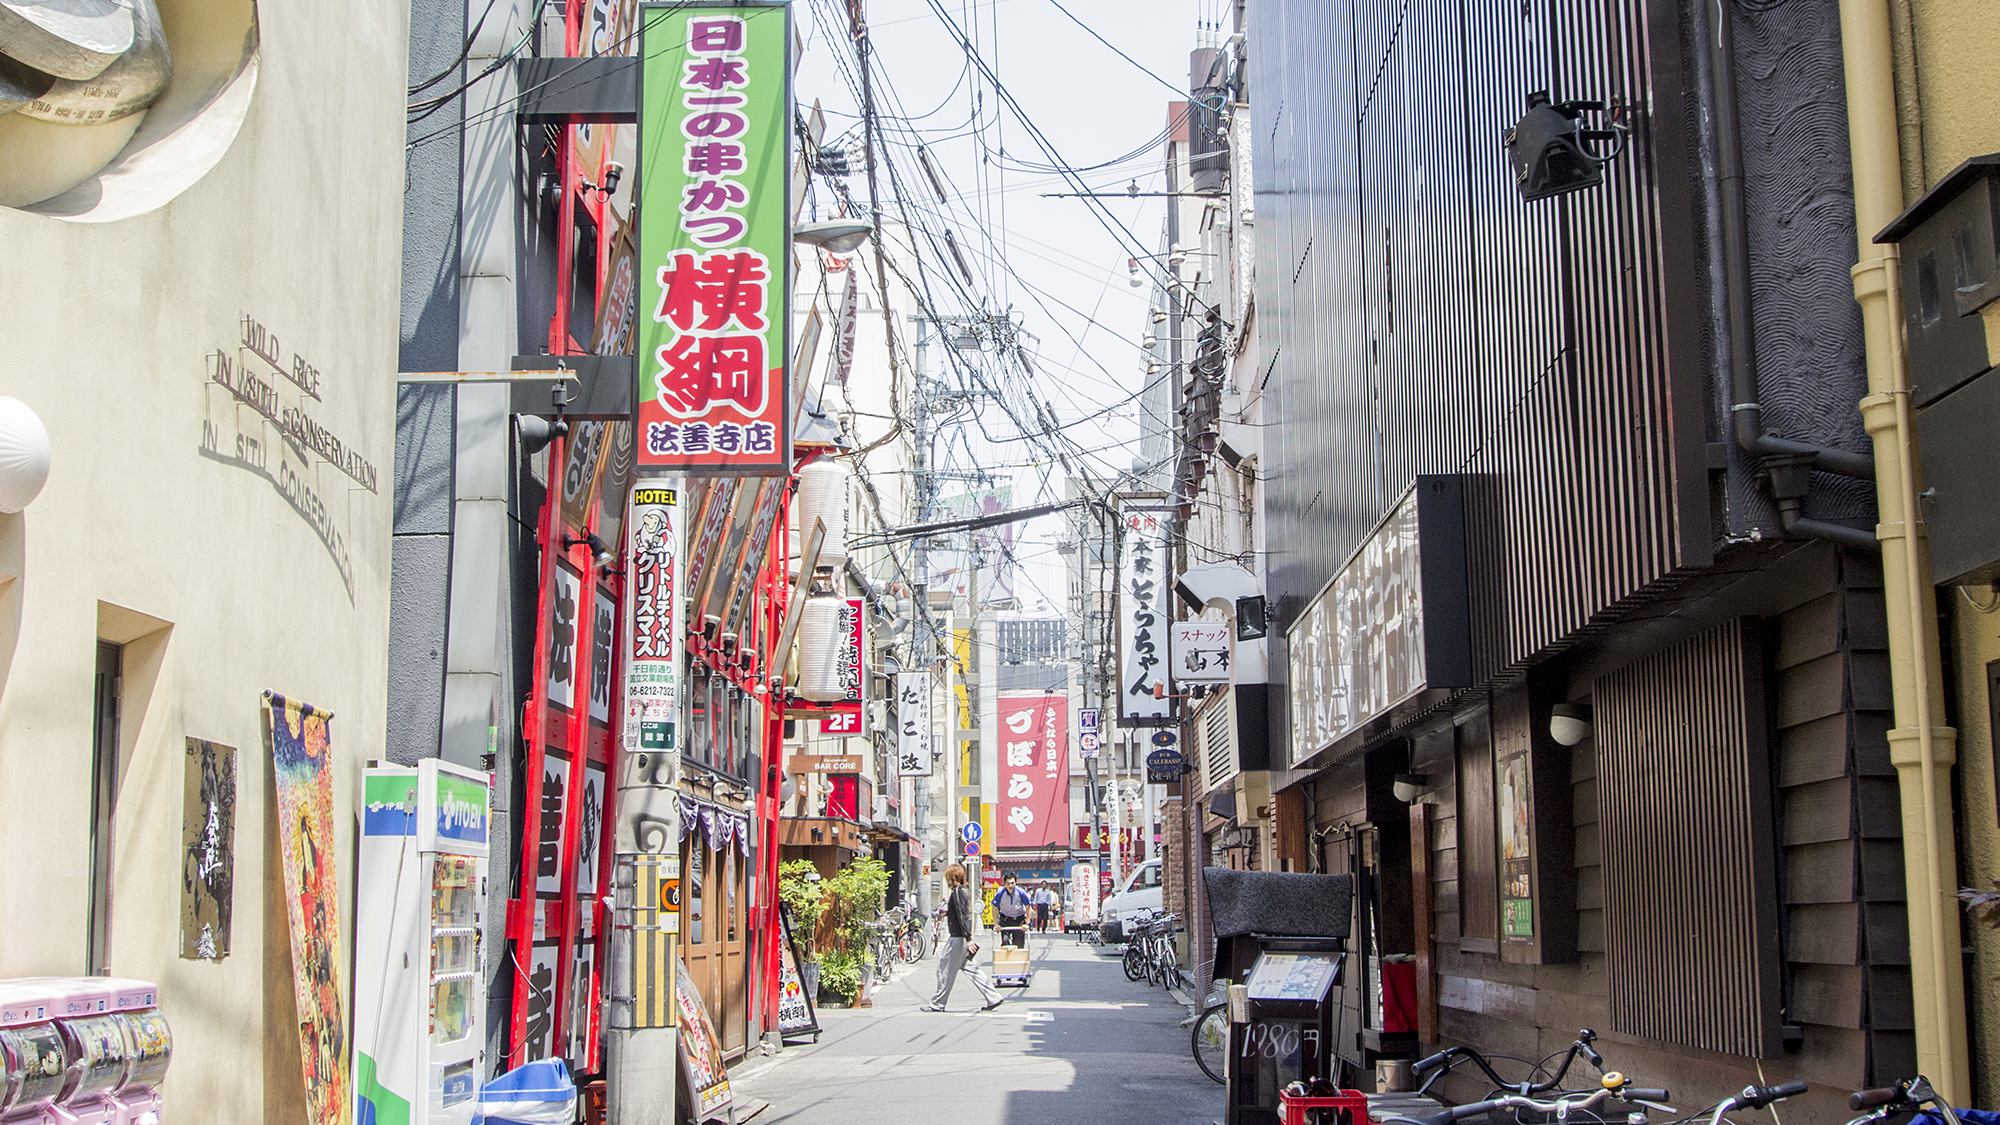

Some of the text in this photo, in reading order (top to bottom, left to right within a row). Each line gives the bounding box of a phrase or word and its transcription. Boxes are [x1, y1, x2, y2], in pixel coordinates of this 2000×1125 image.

[683, 17, 747, 247] 日本一の串かつ
[658, 249, 769, 417] 横綱
[245, 314, 320, 397] WILD RICE
[215, 348, 232, 387] IN
[290, 406, 377, 491] CONSERVATION
[650, 424, 774, 454] 法善寺店
[635, 490, 676, 505] HOTEL
[1127, 515, 1157, 531] 焼肉
[635, 551, 656, 658] クリスマス
[655, 551, 672, 657] リトルチャペル
[1180, 629, 1227, 643] スナック
[633, 664, 672, 674] 千日前通り
[629, 686, 675, 696] 06-6212-7322
[642, 709, 670, 718] こちら
[828, 713, 856, 731] 2F
[901, 684, 923, 771] たこ政
[814, 762, 857, 770] BAR CORE
[1005, 706, 1037, 834] づぼらや
[454, 799, 482, 830] ITOEN
